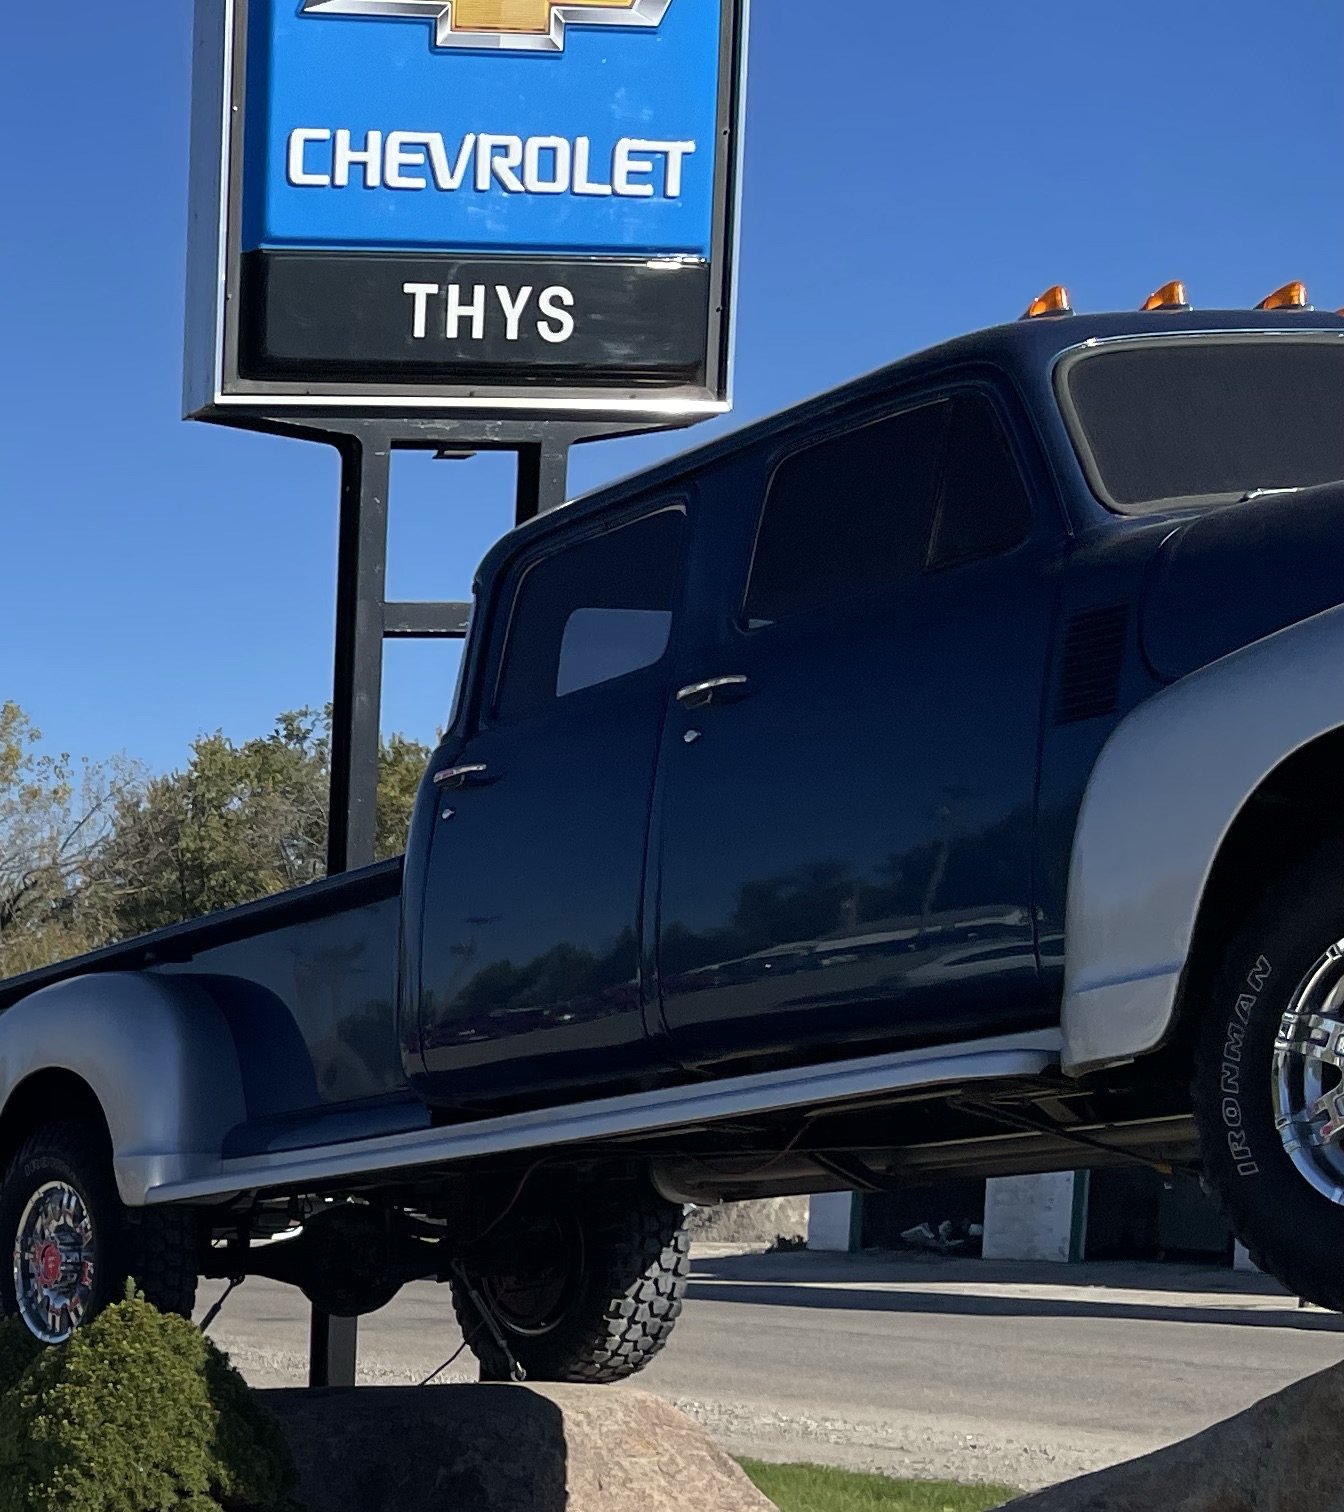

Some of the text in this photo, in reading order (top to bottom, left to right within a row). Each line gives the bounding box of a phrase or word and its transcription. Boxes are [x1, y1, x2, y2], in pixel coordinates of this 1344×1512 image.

[288, 127, 697, 199] CHEVROLET
[403, 282, 575, 343] THYS
[1220, 954, 1273, 1176] IRONMAN
